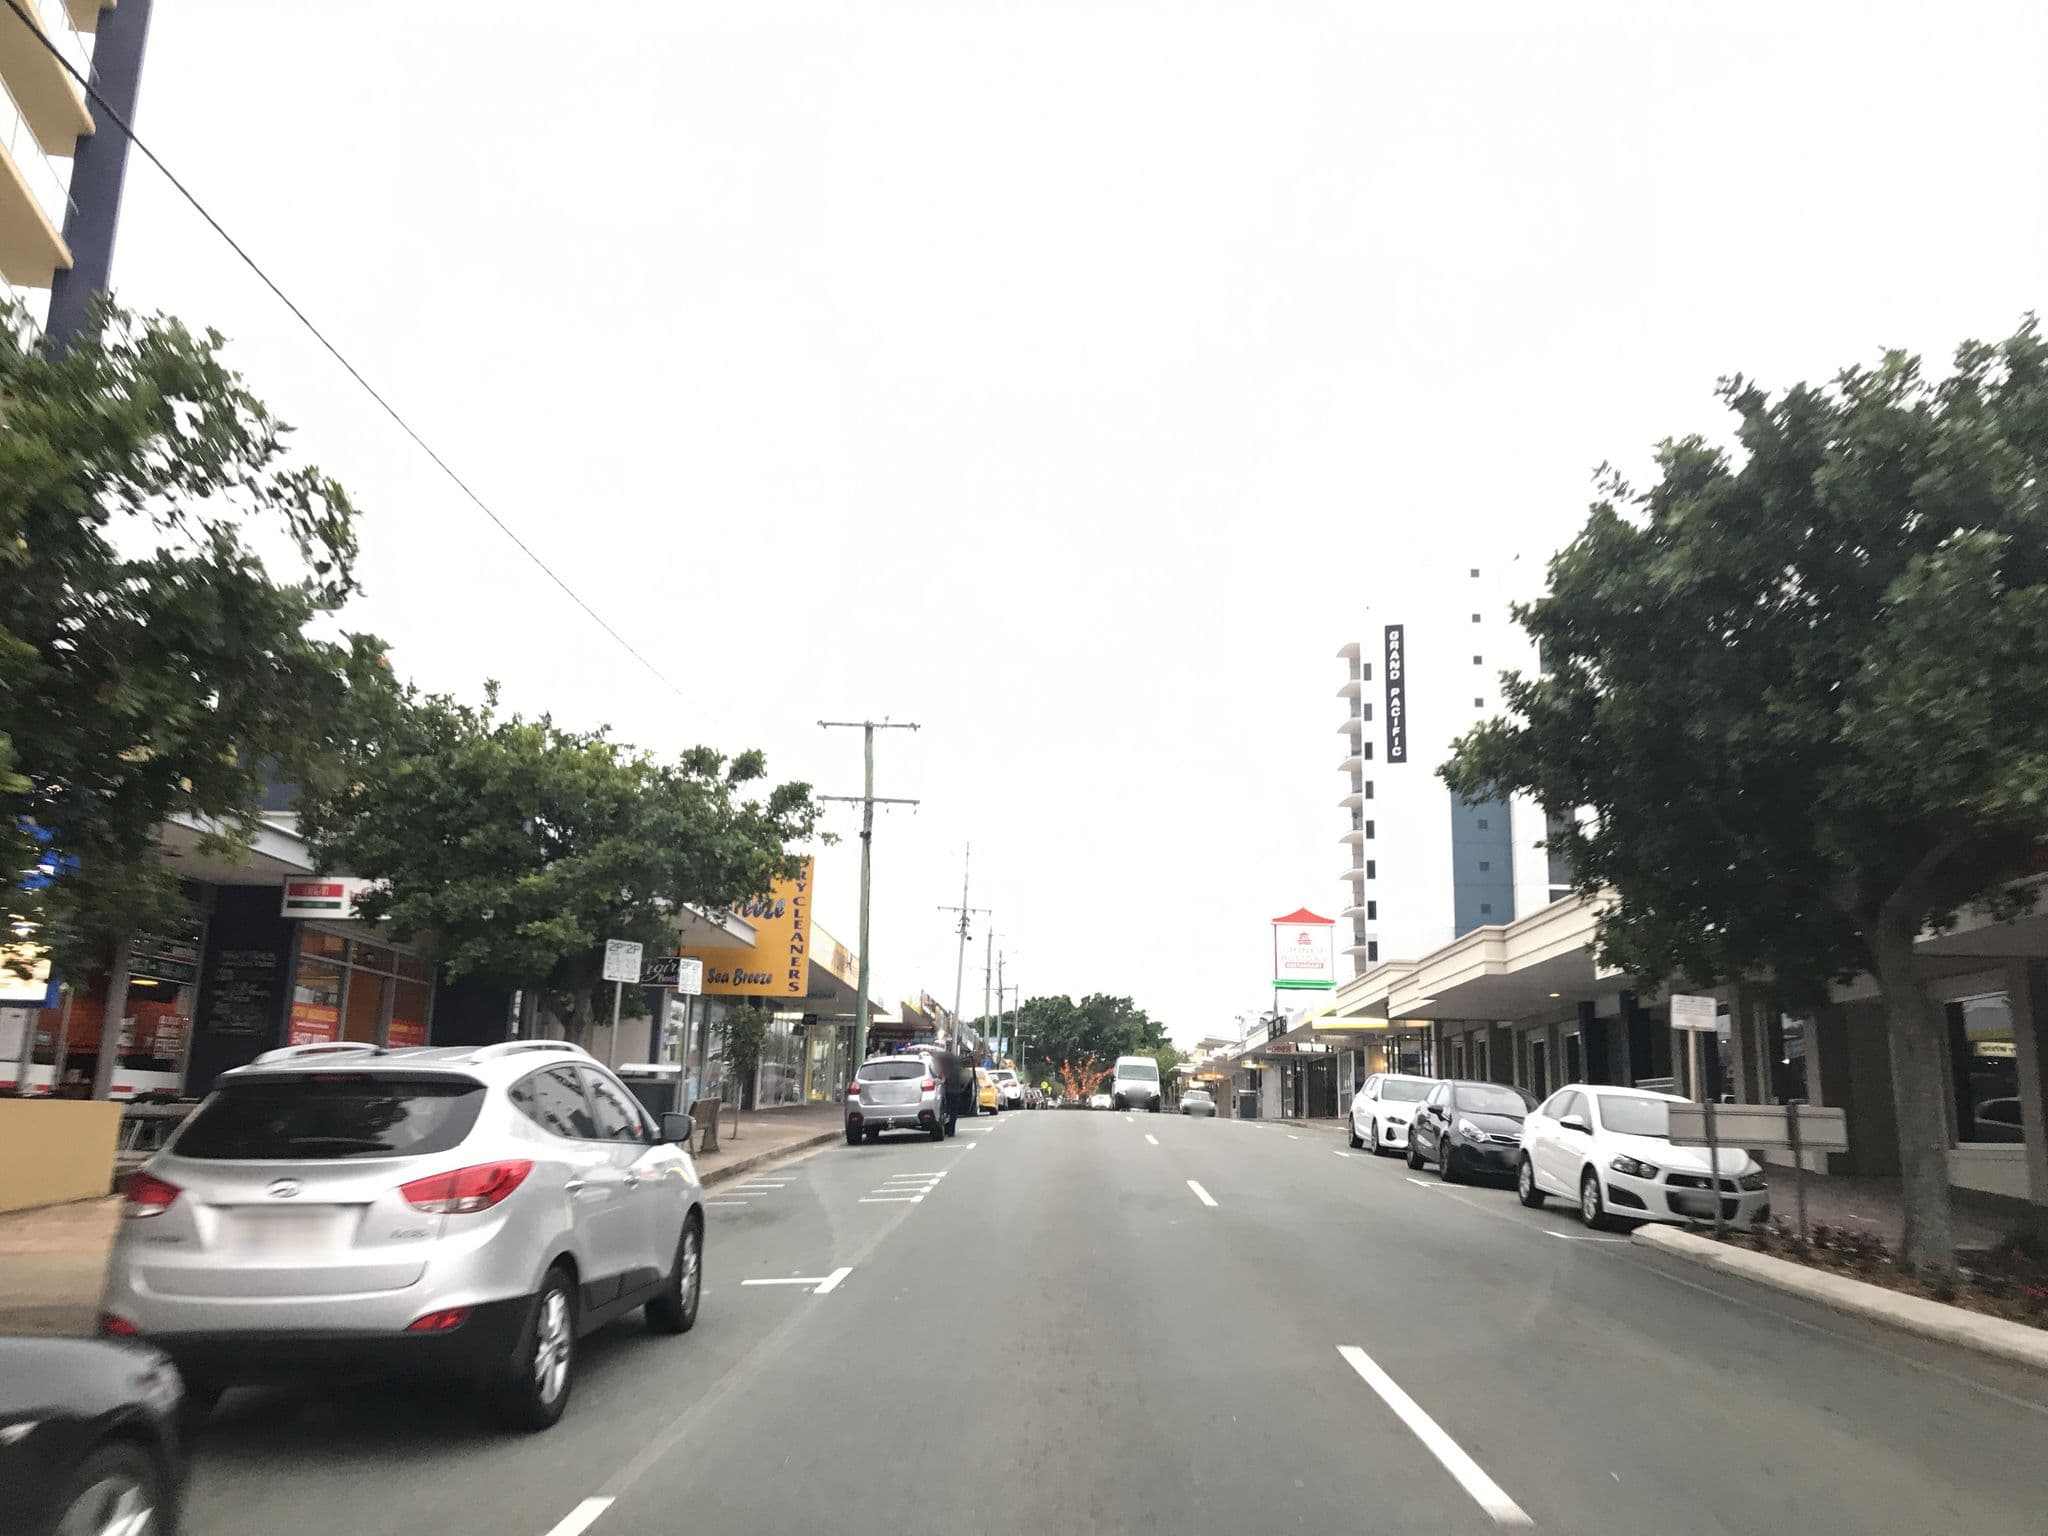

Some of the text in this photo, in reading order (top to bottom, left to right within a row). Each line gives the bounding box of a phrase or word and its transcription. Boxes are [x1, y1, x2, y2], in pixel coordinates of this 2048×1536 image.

[1389, 630, 1403, 757] GRAND PACIFIC
[707, 968, 729, 985] Sea
[733, 968, 773, 987] Breeze
[787, 896, 807, 992] CLEANERS
